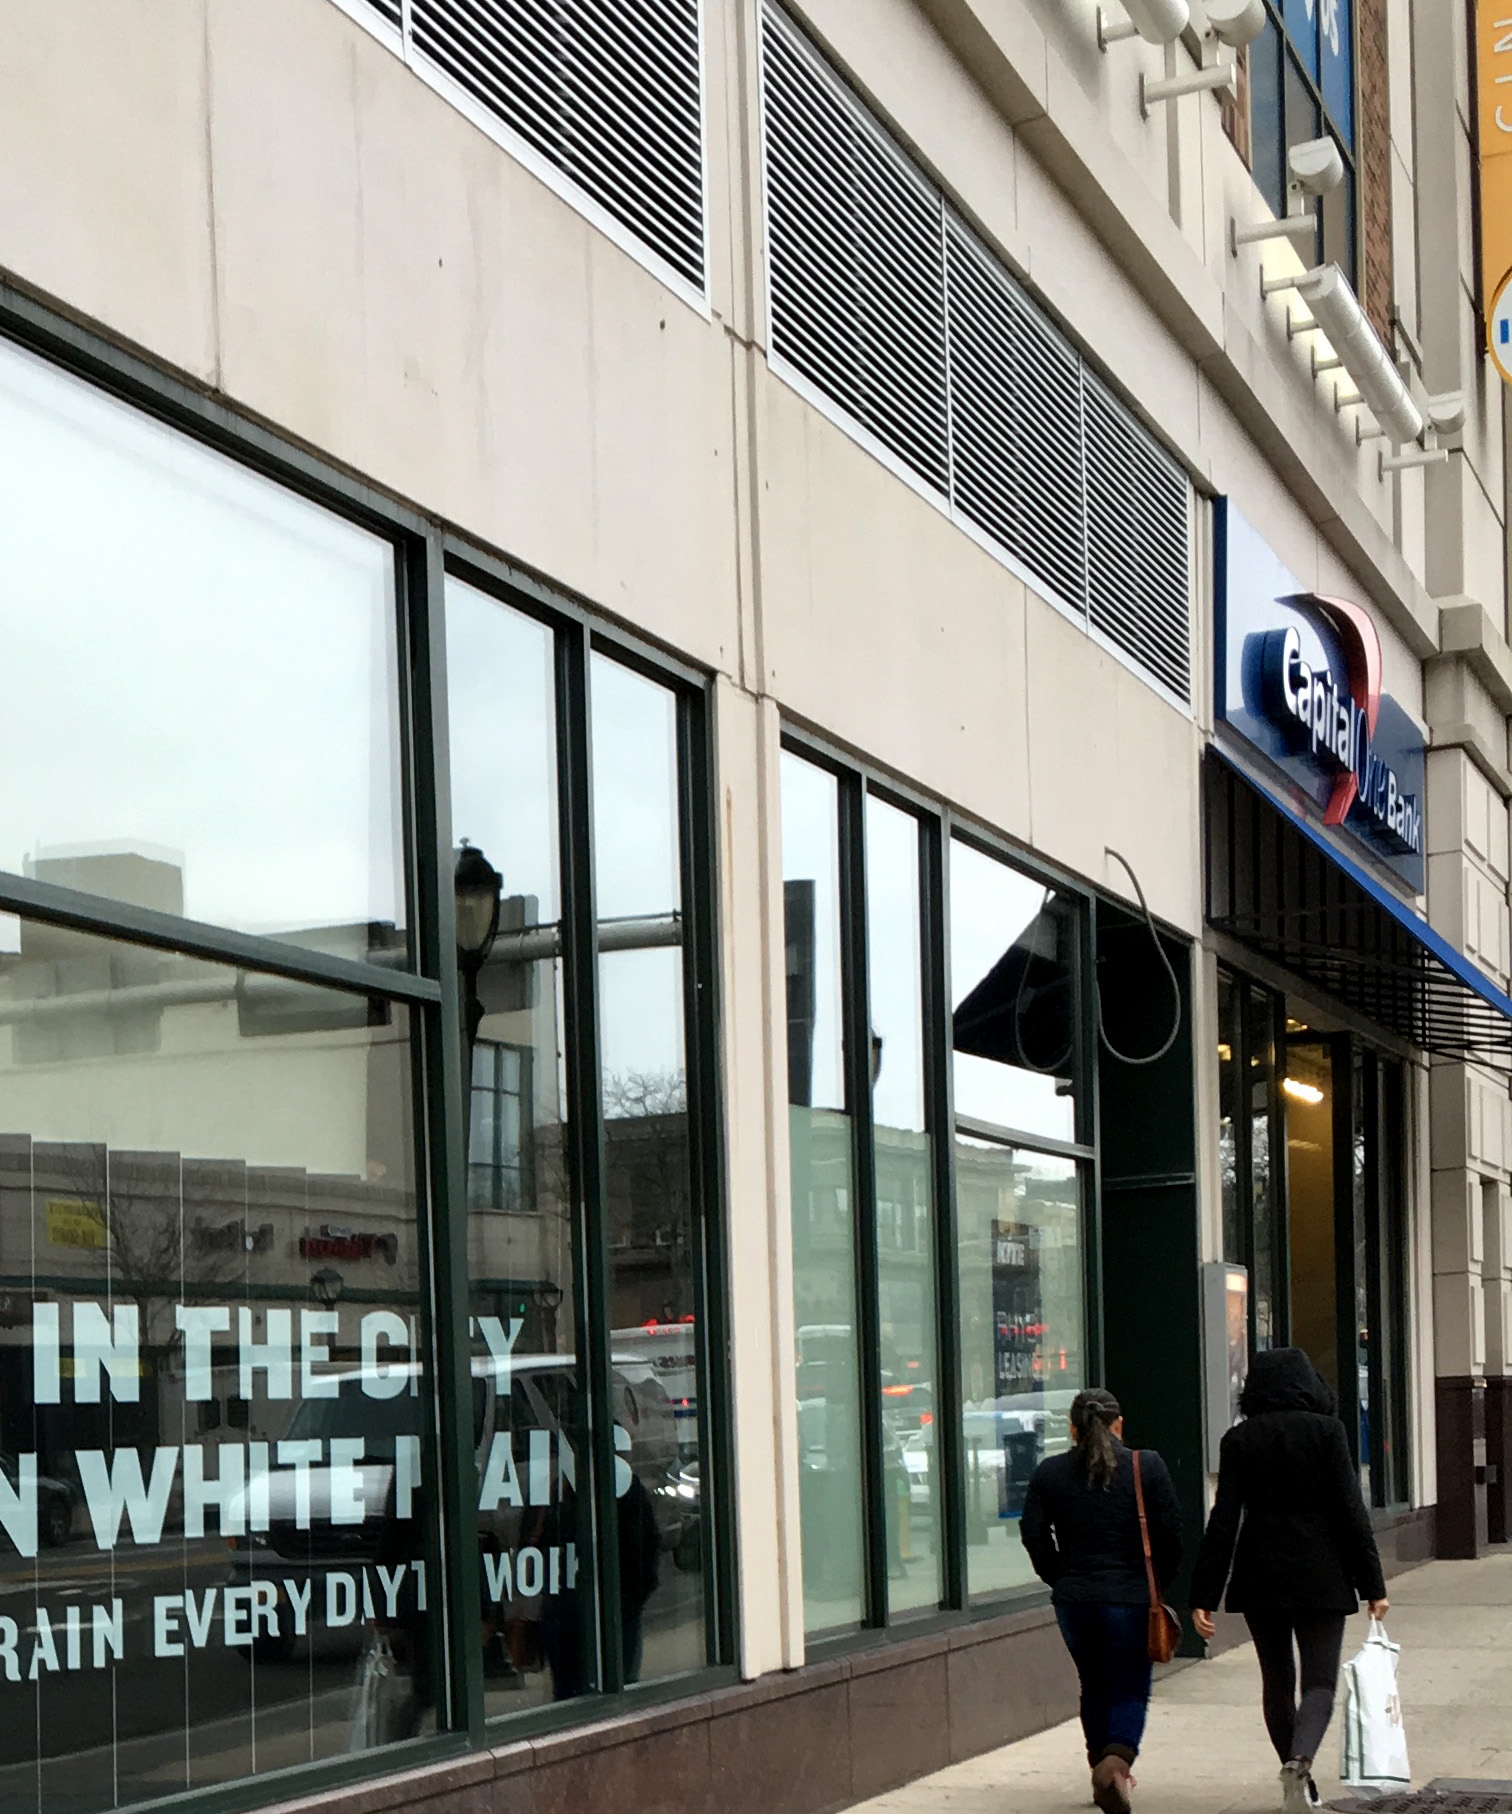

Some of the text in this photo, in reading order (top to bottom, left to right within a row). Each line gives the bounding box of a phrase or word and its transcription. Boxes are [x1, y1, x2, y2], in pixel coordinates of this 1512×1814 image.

[1283, 626, 1356, 772] Capital
[1387, 770, 1421, 853] Bank
[32, 1301, 140, 1405] IN
[175, 1304, 340, 1403] THE
[360, 1310, 524, 1399] CY
[75, 1435, 366, 1551] WHITE
[153, 1578, 311, 1658] EVERY
